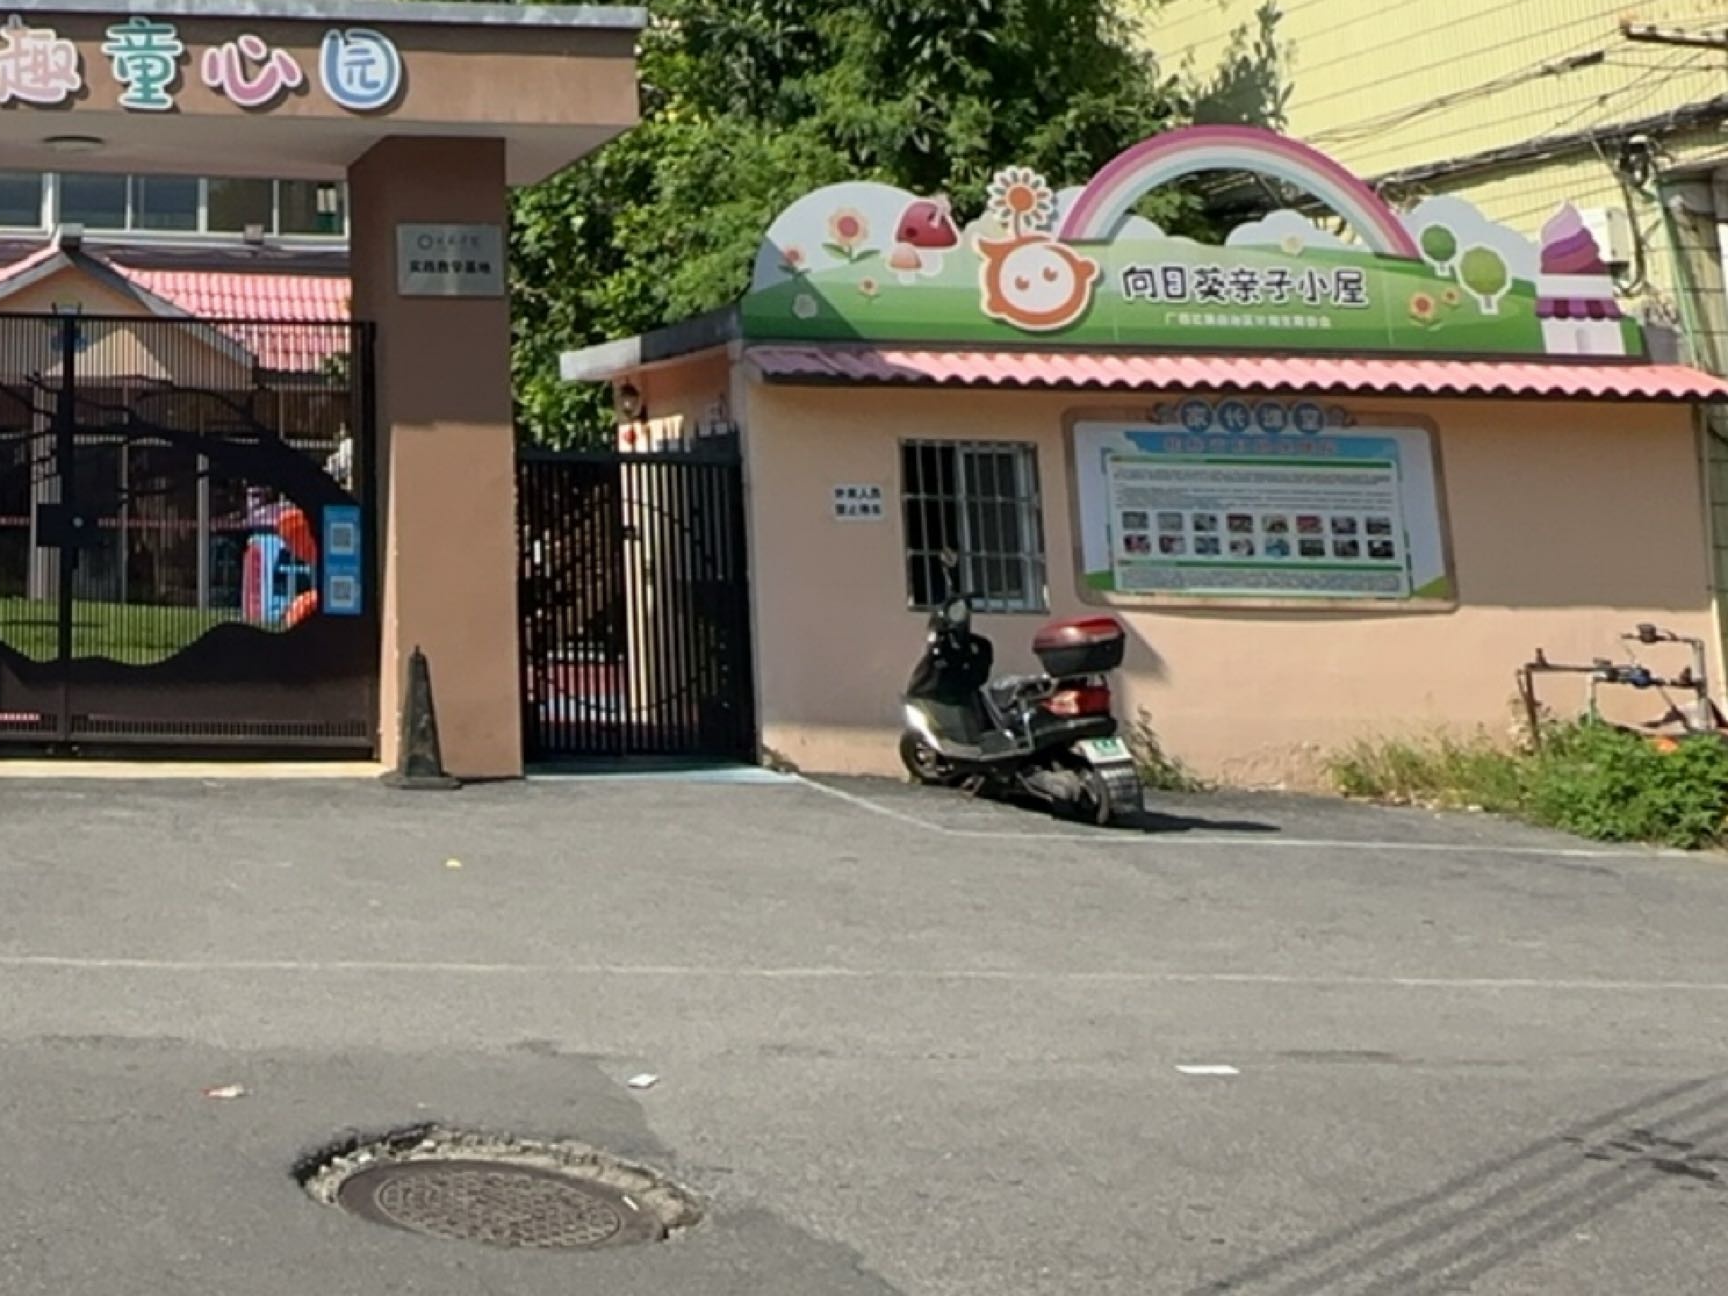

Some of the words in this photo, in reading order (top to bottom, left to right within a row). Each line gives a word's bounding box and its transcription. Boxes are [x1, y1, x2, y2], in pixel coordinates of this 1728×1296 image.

[1122, 264, 1368, 307] 向日葵亲子小屋
